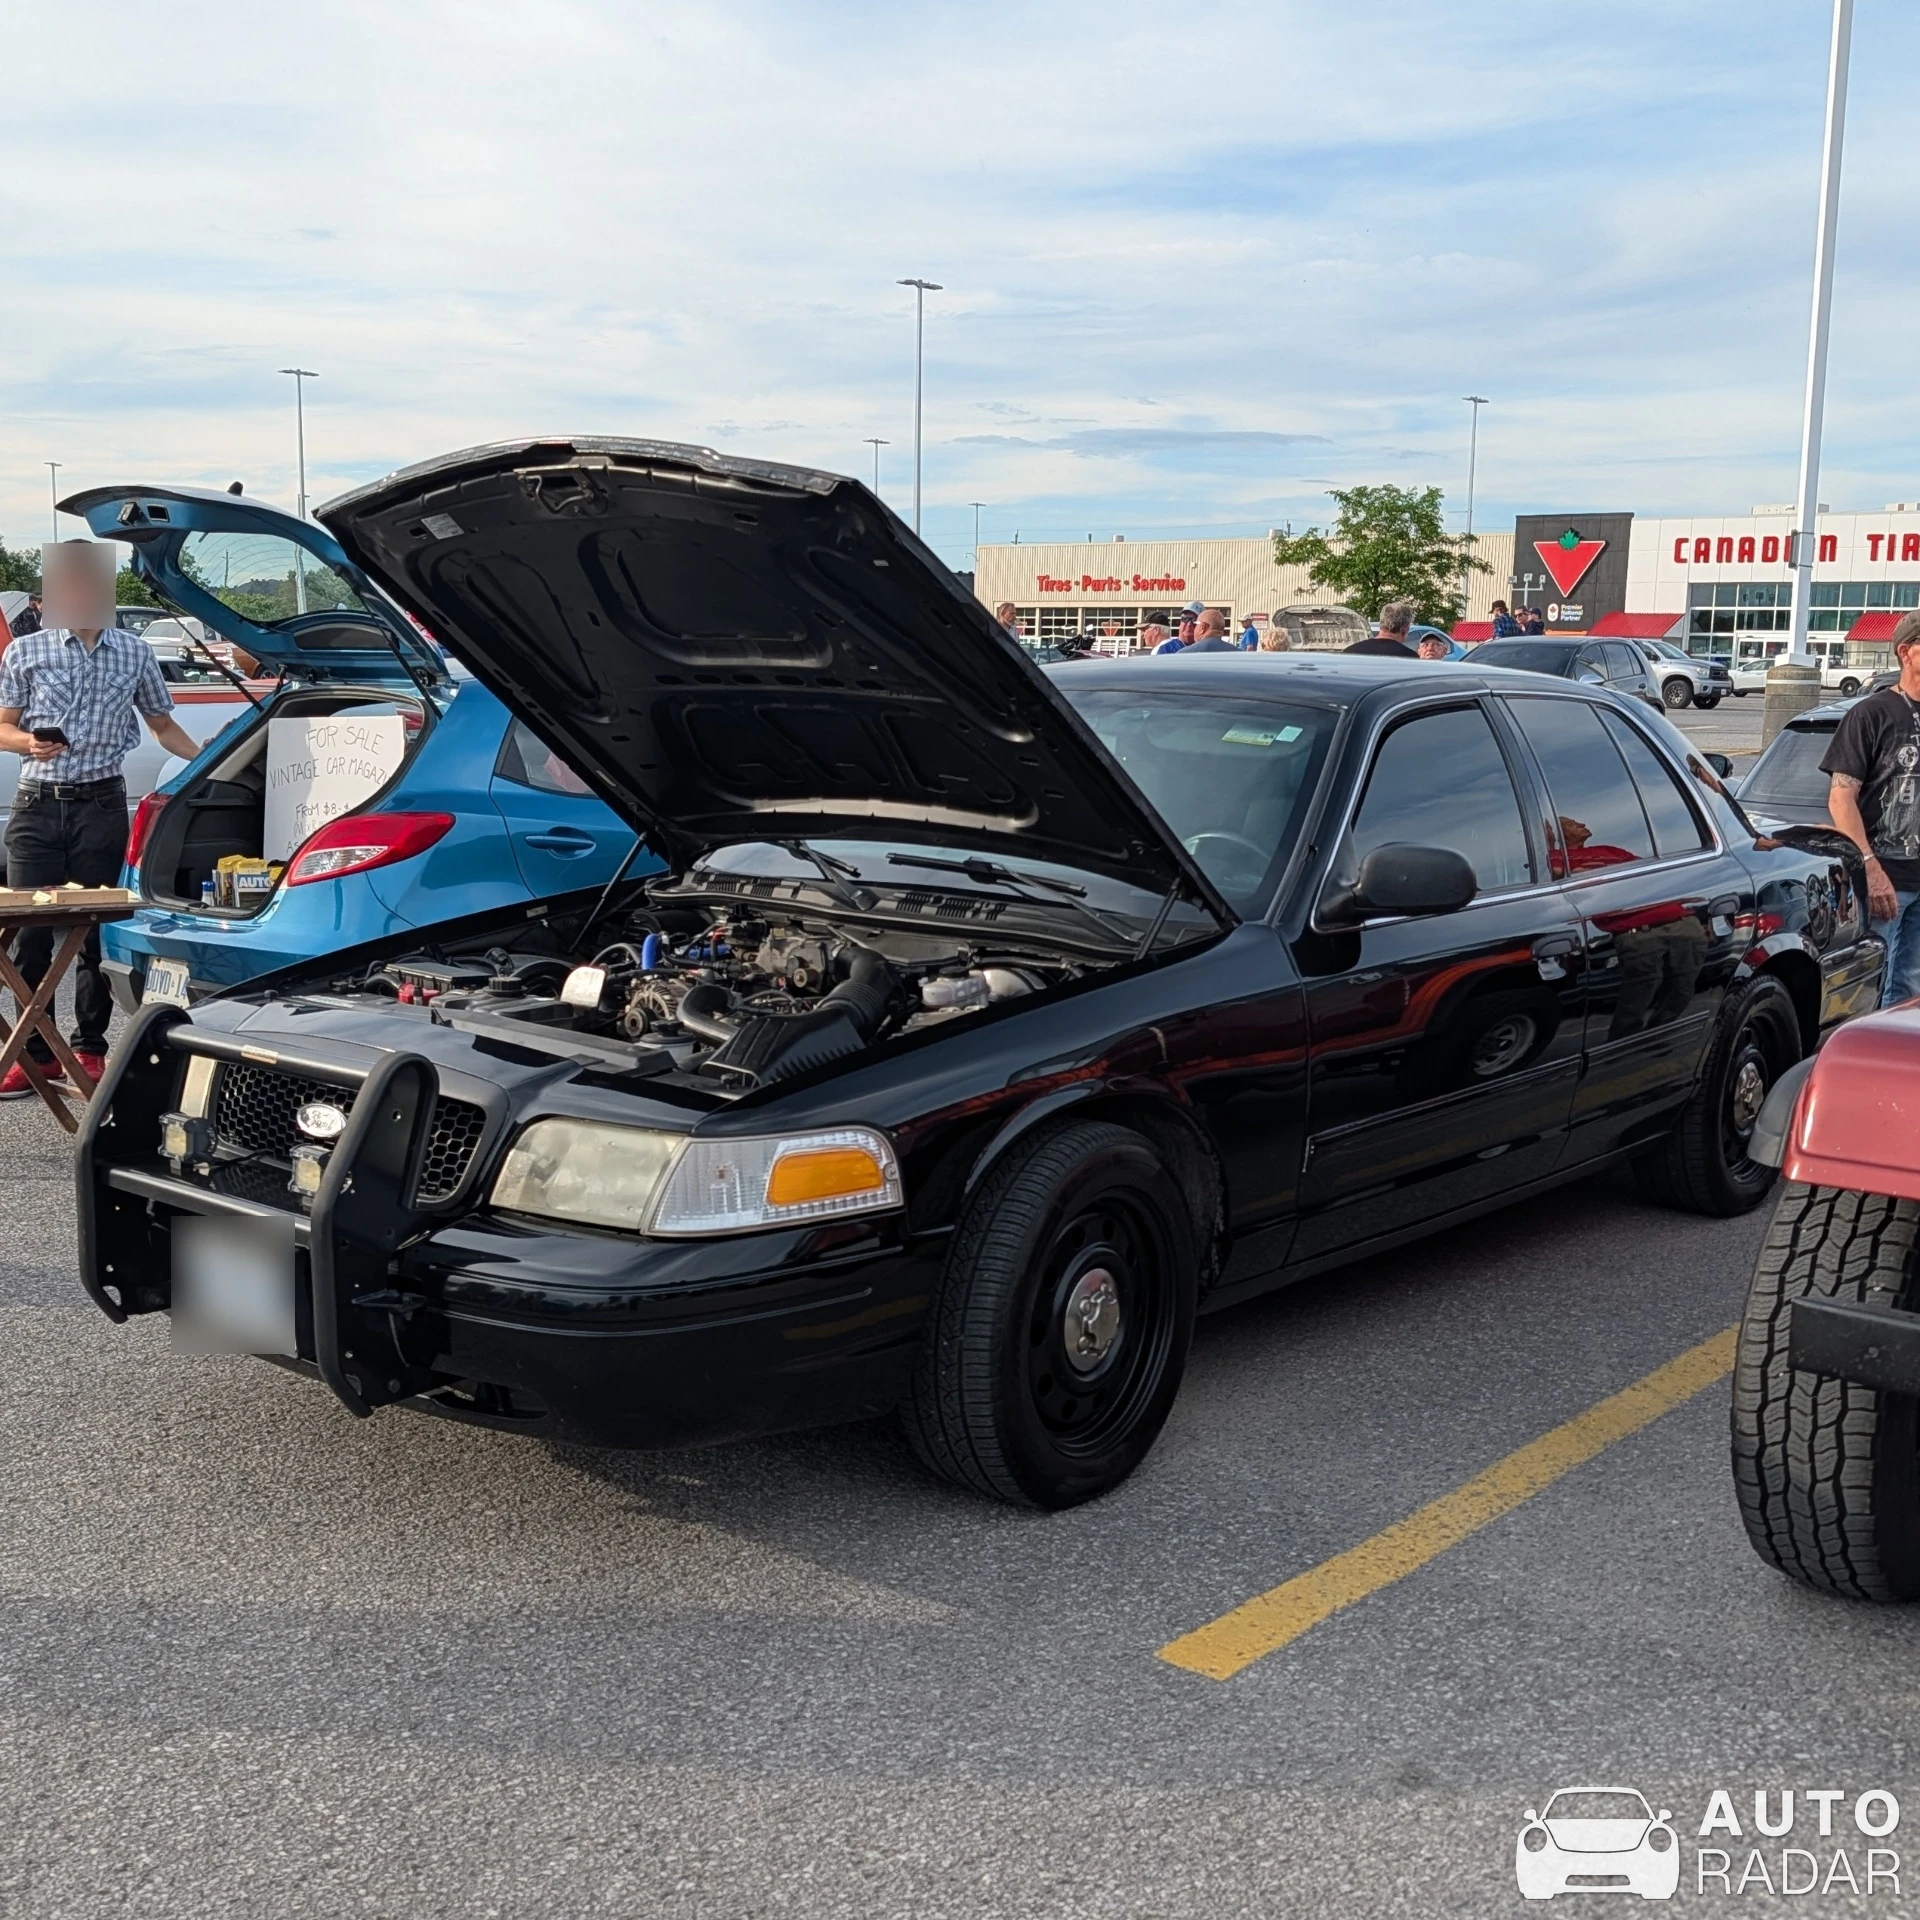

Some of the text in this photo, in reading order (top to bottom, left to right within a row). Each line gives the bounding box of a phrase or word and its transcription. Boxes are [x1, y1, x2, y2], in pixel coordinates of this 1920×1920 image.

[1674, 535, 1837, 563] CANADIN
[1037, 573, 1186, 592] Tires Parts Service
[307, 725, 383, 755] FOR SALE
[269, 757, 388, 789] VINTAGE CAR MAGAZI
